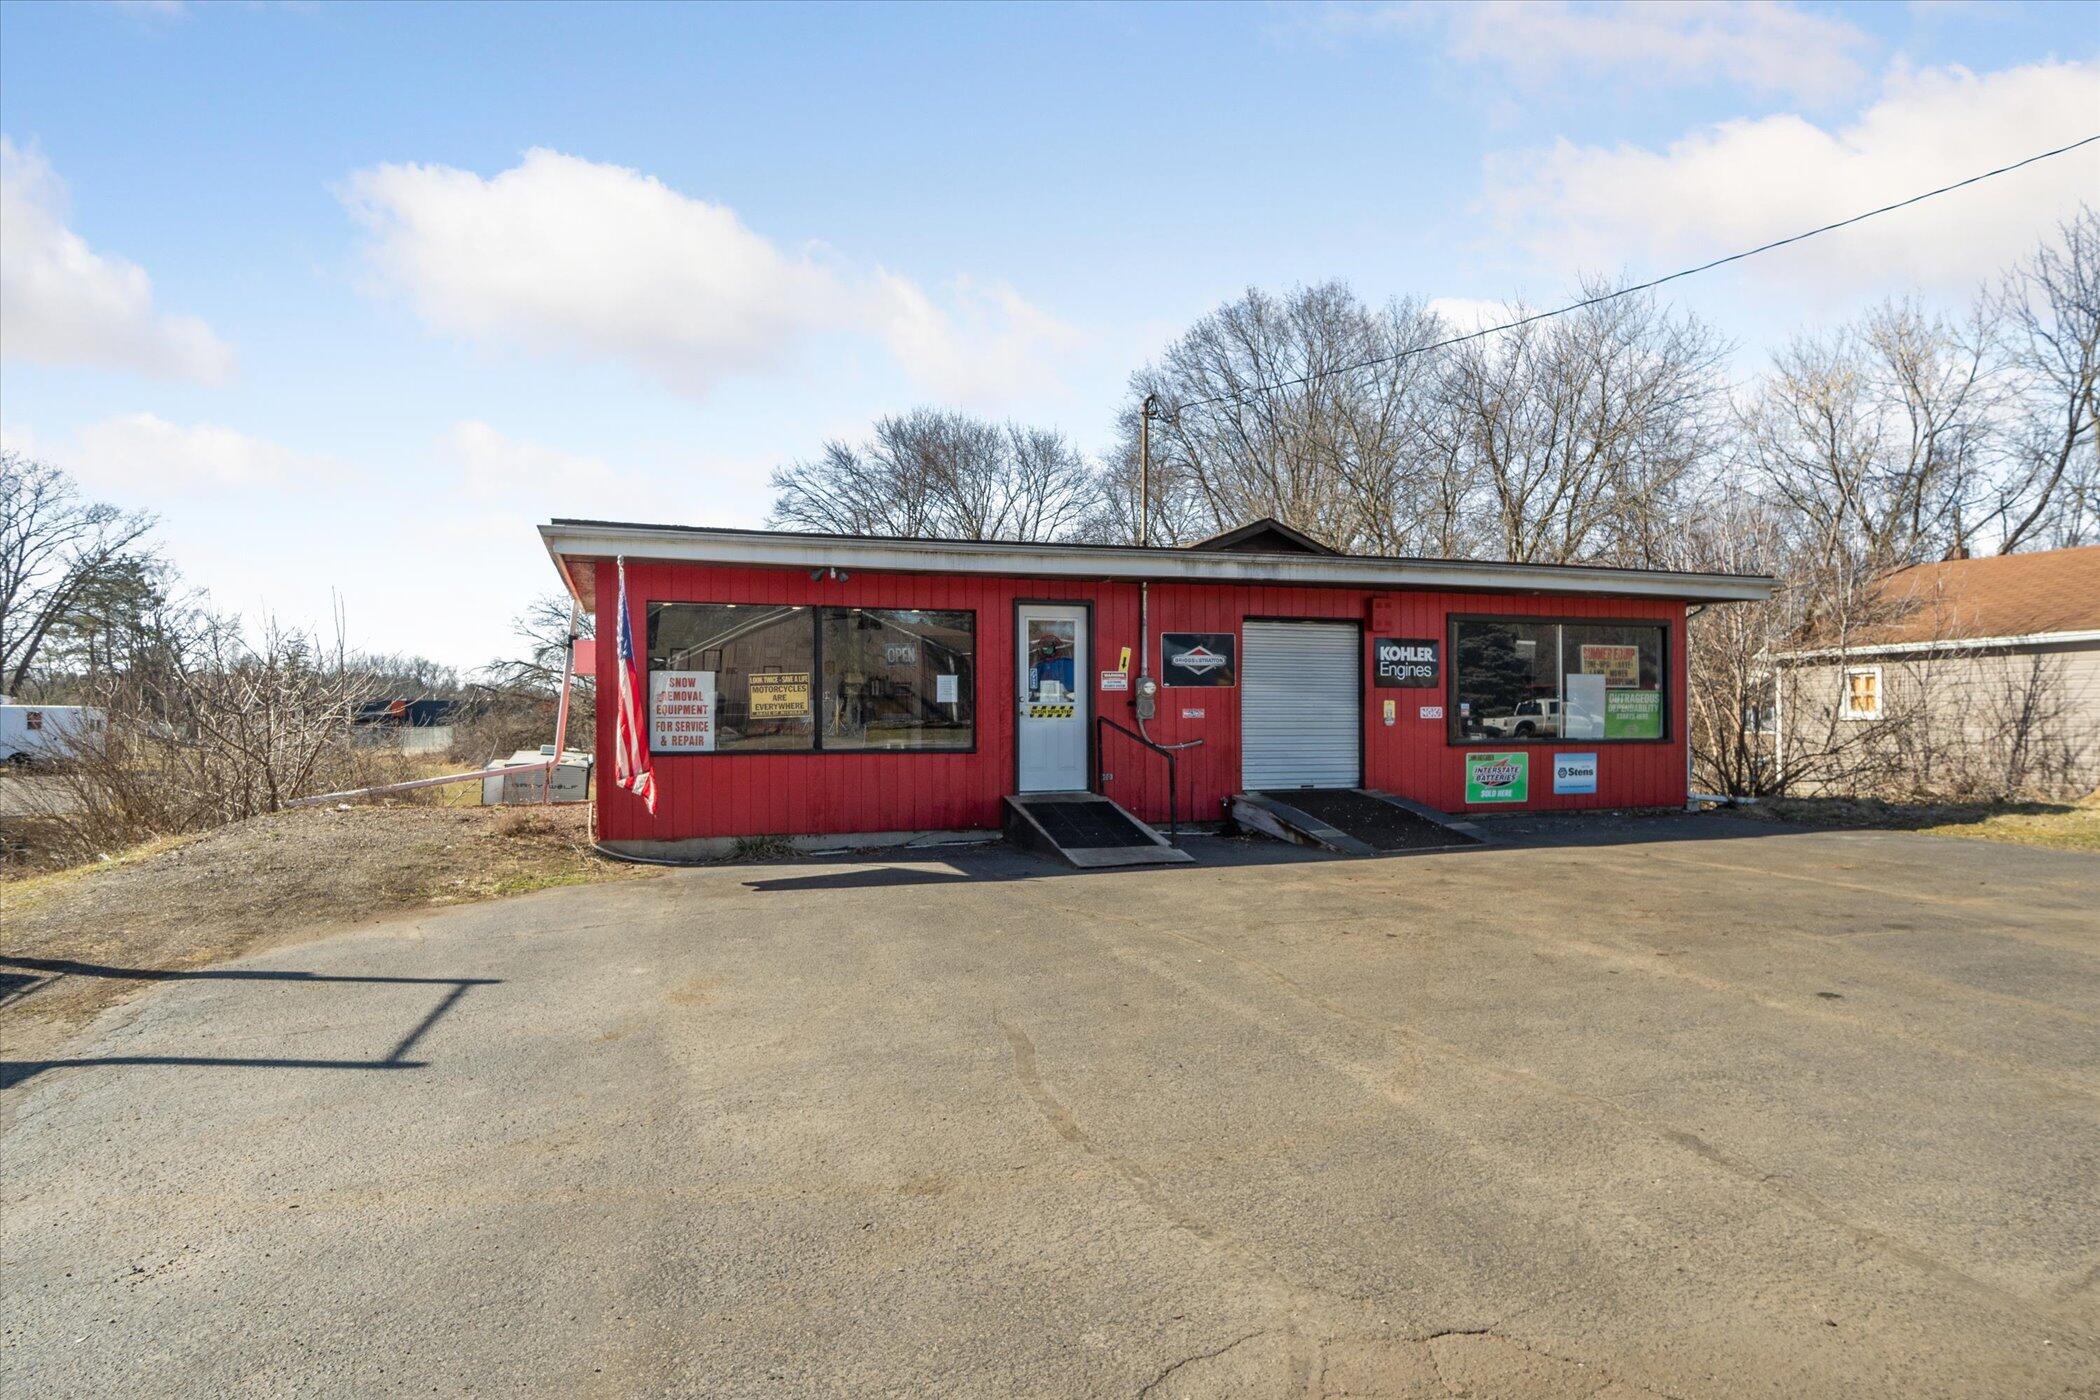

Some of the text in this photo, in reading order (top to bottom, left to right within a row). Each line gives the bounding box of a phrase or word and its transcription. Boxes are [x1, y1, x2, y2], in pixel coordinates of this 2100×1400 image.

[887, 647, 916, 663] OPEN
[1380, 661, 1432, 680] Engines
[669, 677, 696, 688] SNOW
[752, 685, 806, 693] MOTORCYCLES
[1609, 693, 1660, 703] OUTRAGEOUS
[656, 705, 708, 715] EQUIPMENT
[755, 702, 805, 710] EVERYWHERE
[1608, 703, 1659, 712] DEPENDABILITY
[656, 721, 709, 732] FOR SERVICE
[660, 736, 704, 746] & REPAIR
[1474, 766, 1519, 775] INTERSTATE
[1568, 767, 1594, 776] Stens
[1476, 774, 1516, 782] BATTERIES
[1481, 789, 1512, 798] SOLD HERE
